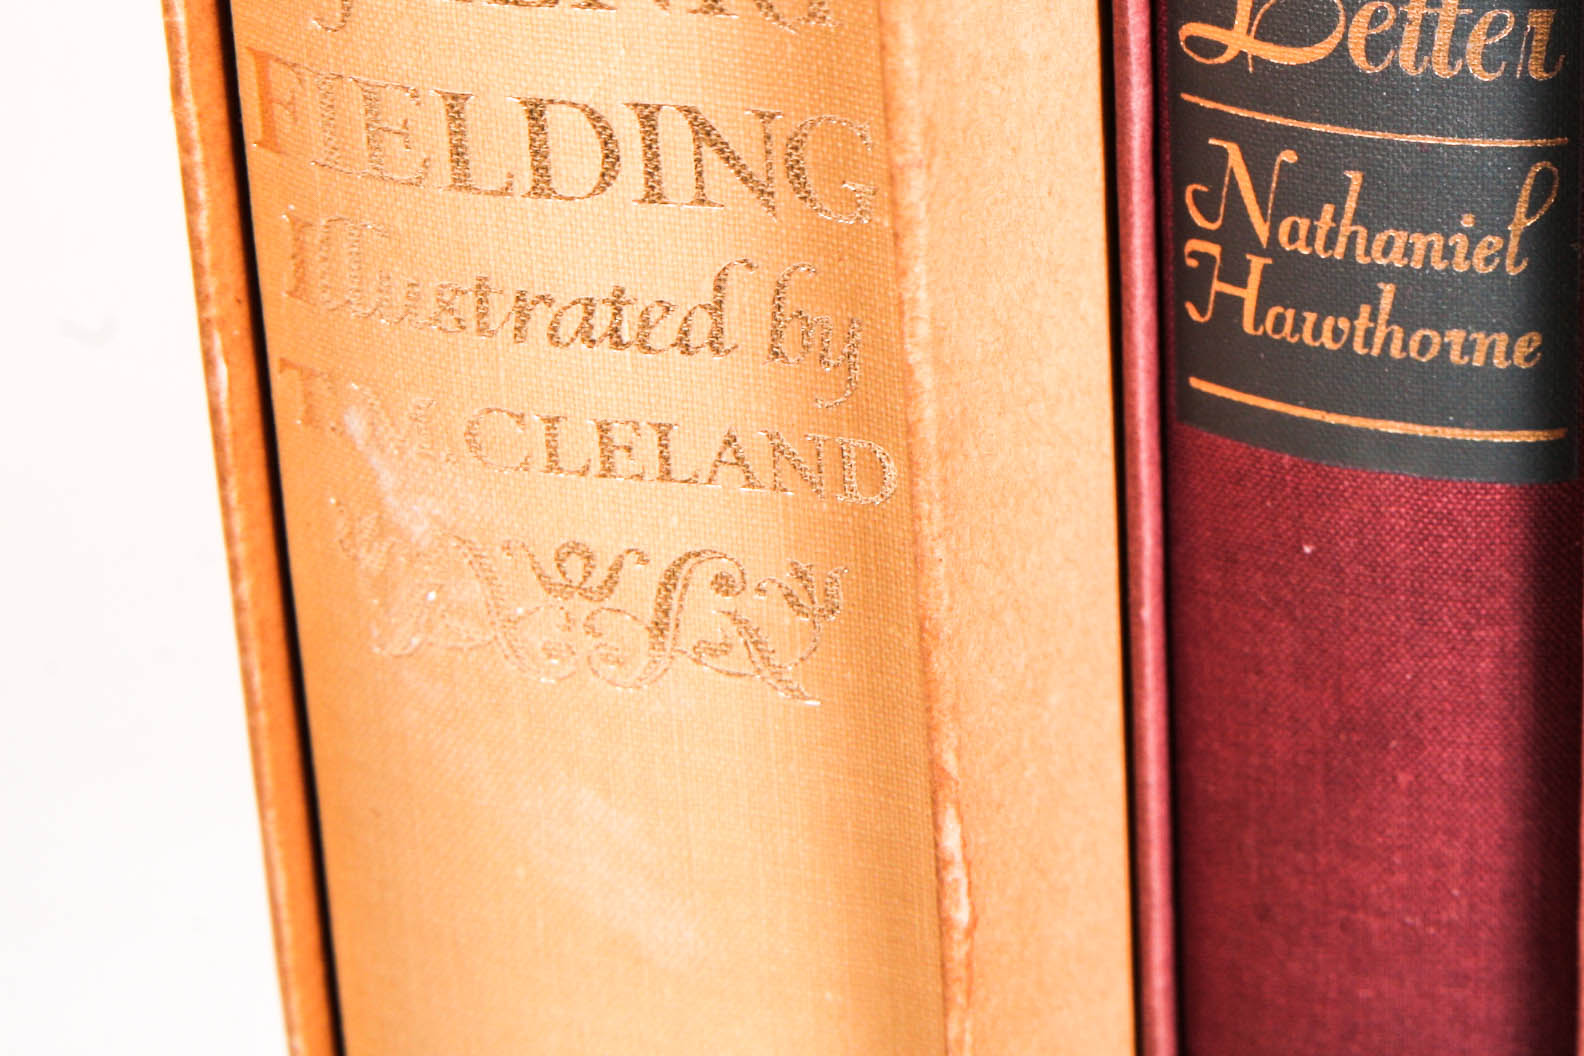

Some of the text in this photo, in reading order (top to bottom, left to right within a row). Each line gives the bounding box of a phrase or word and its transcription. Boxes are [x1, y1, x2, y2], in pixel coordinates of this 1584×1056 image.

[246, 47, 878, 225] FIELDING
[1184, 138, 1560, 275] Nathaniel
[281, 210, 862, 409] Illustrated by
[1184, 238, 1543, 369] Hawthorne
[463, 407, 899, 506] CLELAND
